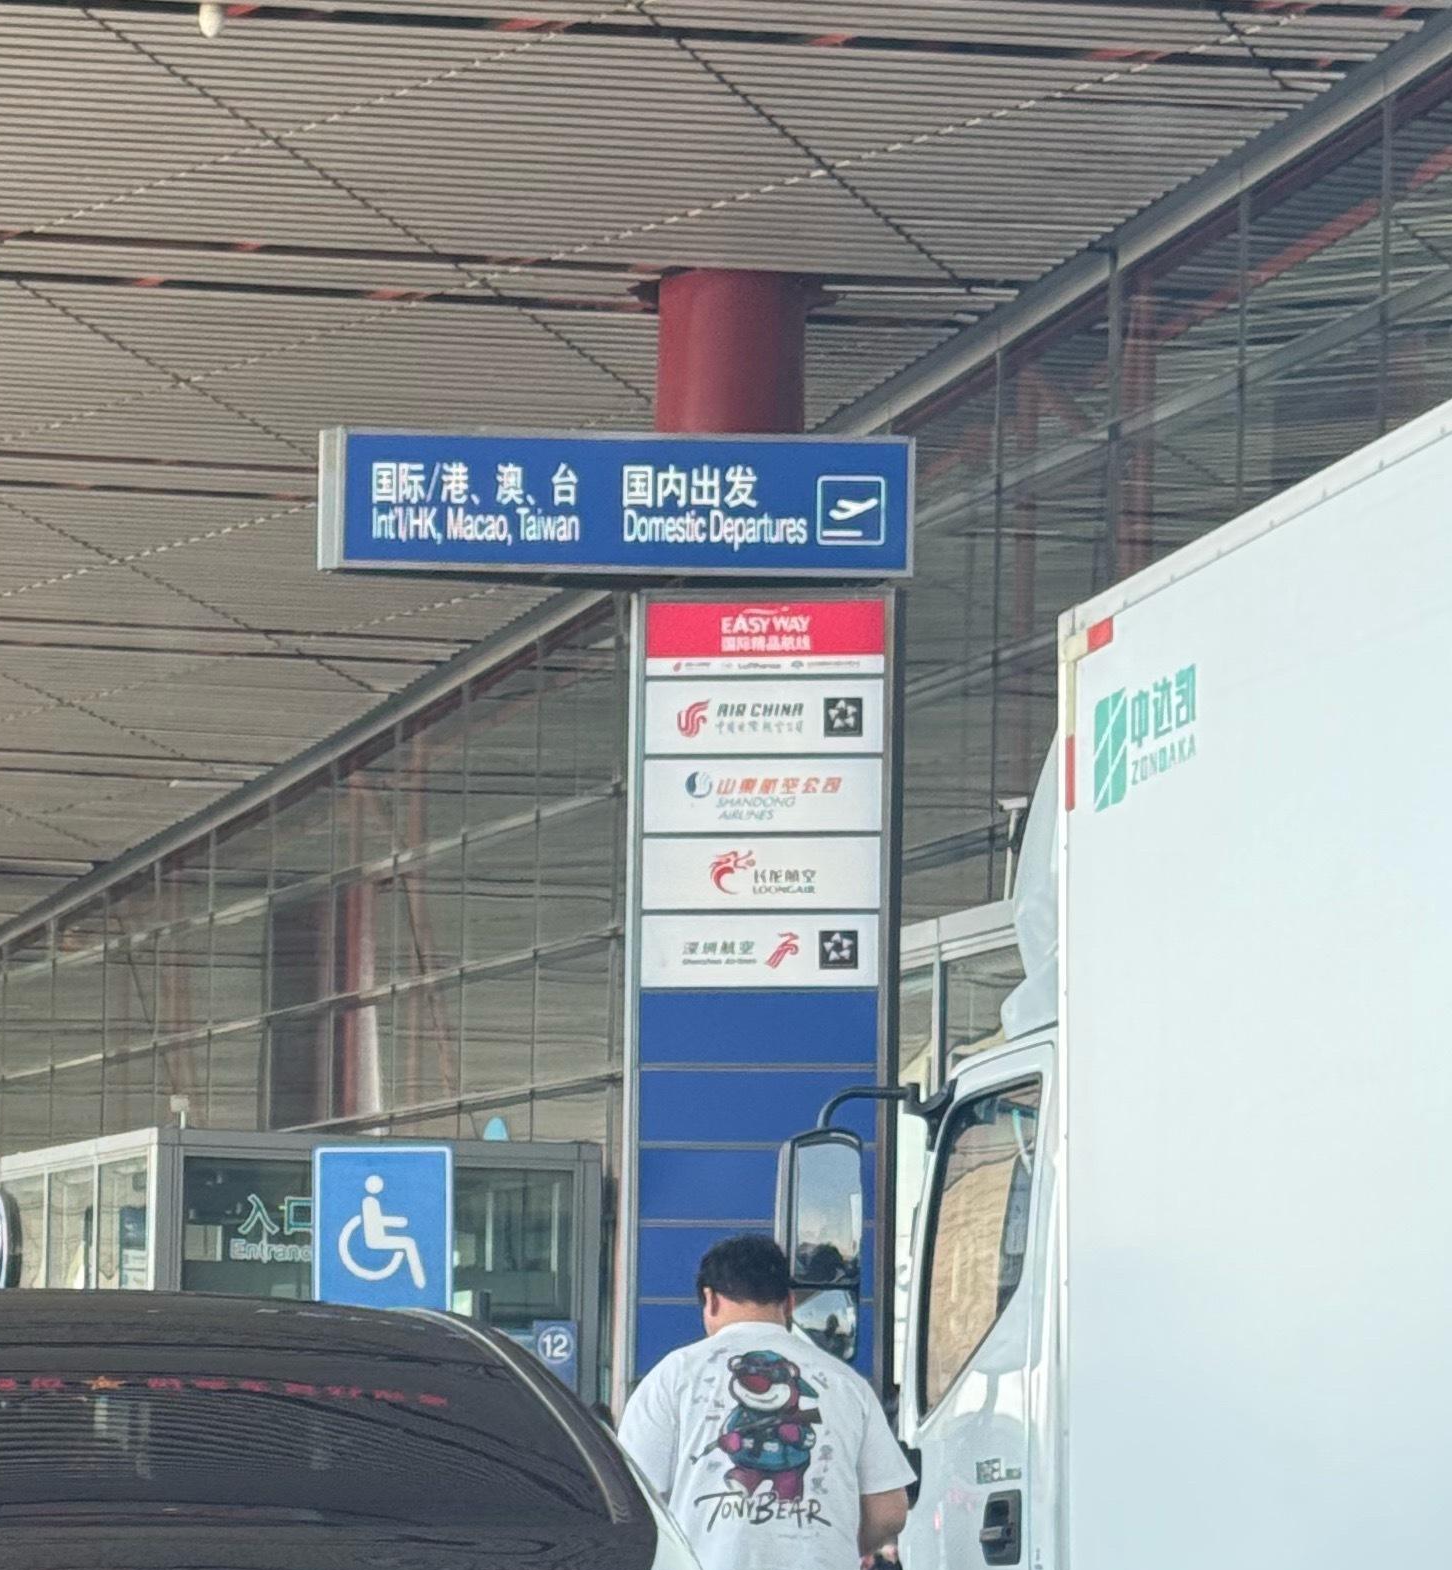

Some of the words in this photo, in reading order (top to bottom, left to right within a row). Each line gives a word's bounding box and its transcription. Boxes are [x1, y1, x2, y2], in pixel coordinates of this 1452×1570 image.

[622, 463, 758, 508] 国内出发
[447, 507, 513, 546] Macao,
[516, 507, 581, 542] Taiwan
[623, 509, 707, 544] Domestic
[709, 509, 809, 552] Departures
[721, 616, 771, 634] EASY
[773, 615, 812, 633] WAY
[716, 703, 746, 718] AIR
[750, 703, 805, 718] CHINA
[237, 1193, 311, 1235] 入口
[230, 1238, 311, 1262] Entranc
[542, 1333, 568, 1358] 12
